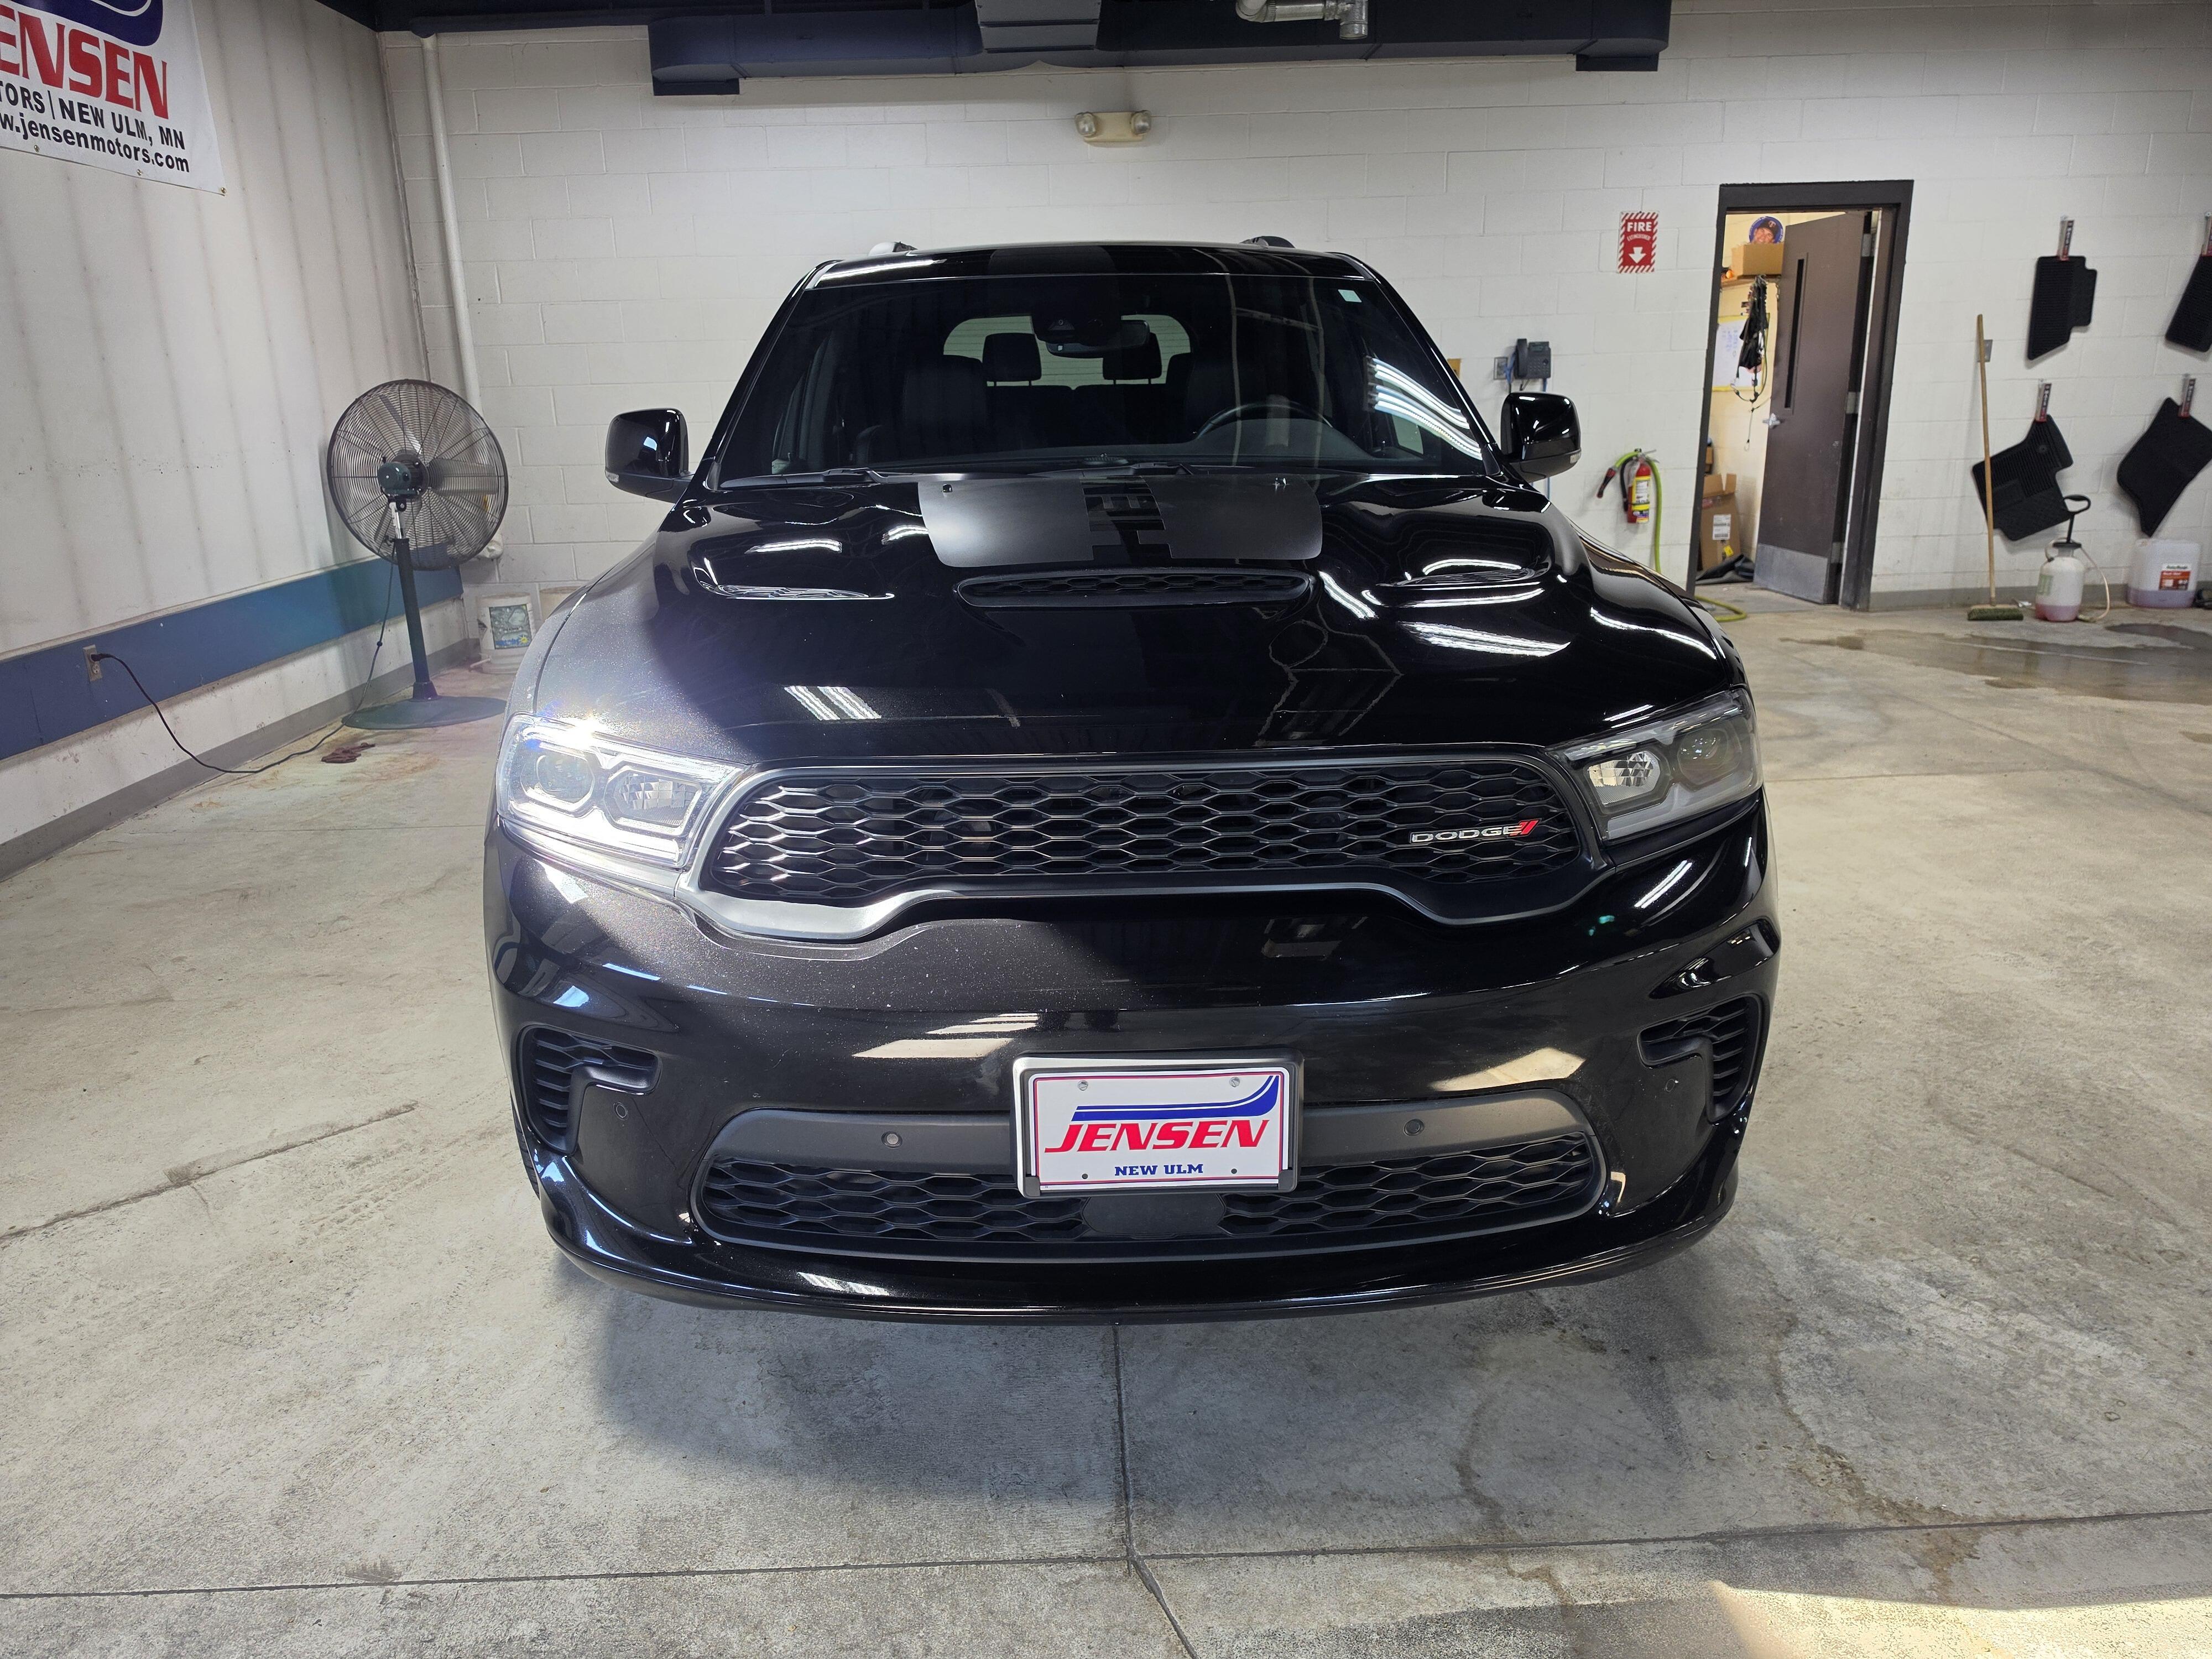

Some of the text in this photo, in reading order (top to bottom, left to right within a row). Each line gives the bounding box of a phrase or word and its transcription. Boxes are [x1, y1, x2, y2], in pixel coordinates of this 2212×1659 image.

[59, 97, 105, 129] NEW
[111, 112, 153, 146] ULM,
[159, 126, 185, 150] MN
[1627, 221, 1652, 232] FIRE
[1411, 825, 1522, 842] DODGE
[1044, 1119, 1270, 1153] JENSEN
[1114, 1164, 1203, 1176] NEW ULM
